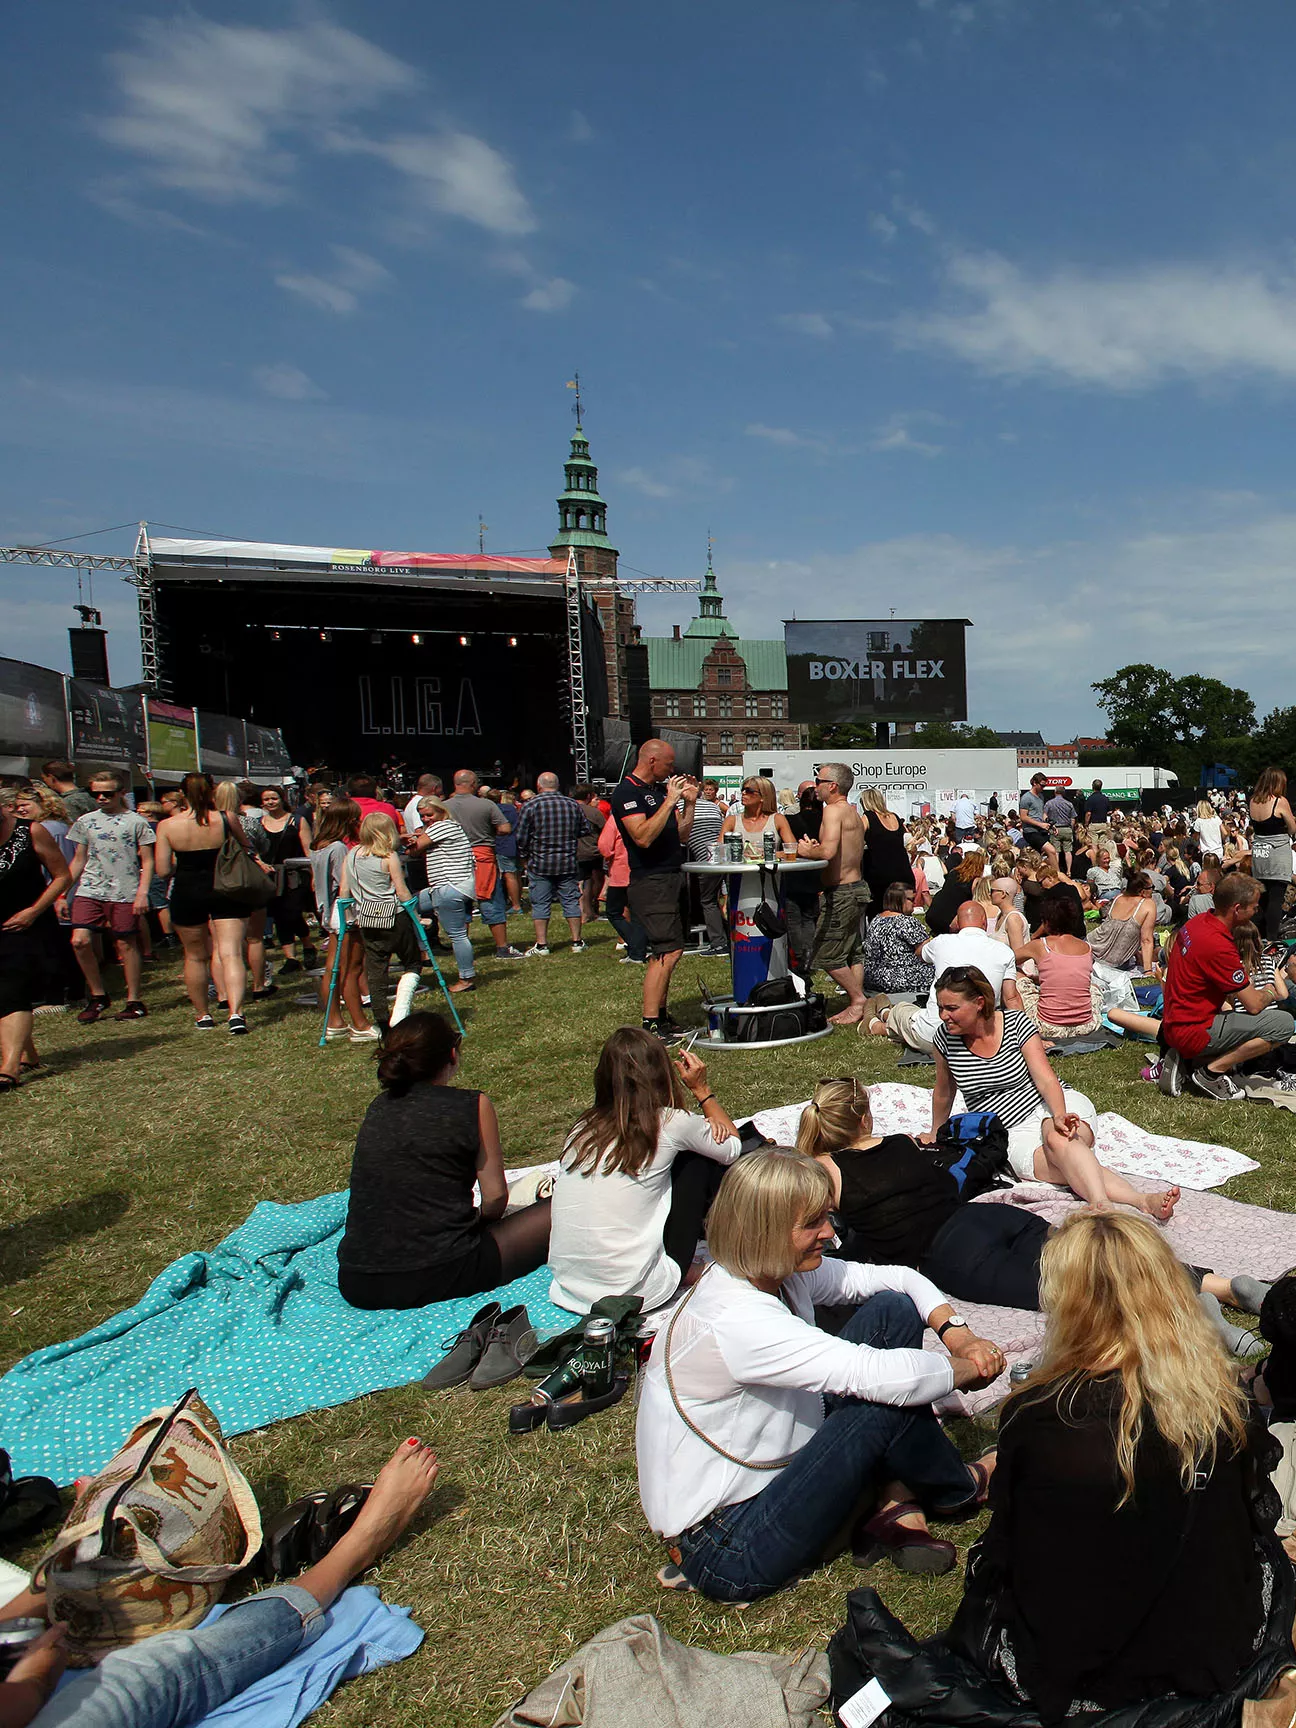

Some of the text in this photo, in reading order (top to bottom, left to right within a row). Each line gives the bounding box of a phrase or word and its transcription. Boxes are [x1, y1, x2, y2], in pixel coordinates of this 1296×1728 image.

[332, 564, 411, 575] ROSENBORG LIVE
[809, 660, 945, 680] BOXER FLEX
[852, 763, 927, 778] Shop Europe
[940, 792, 954, 801] LIVE
[1006, 792, 1018, 801] LIVE
[582, 1360, 607, 1371] OYAL
